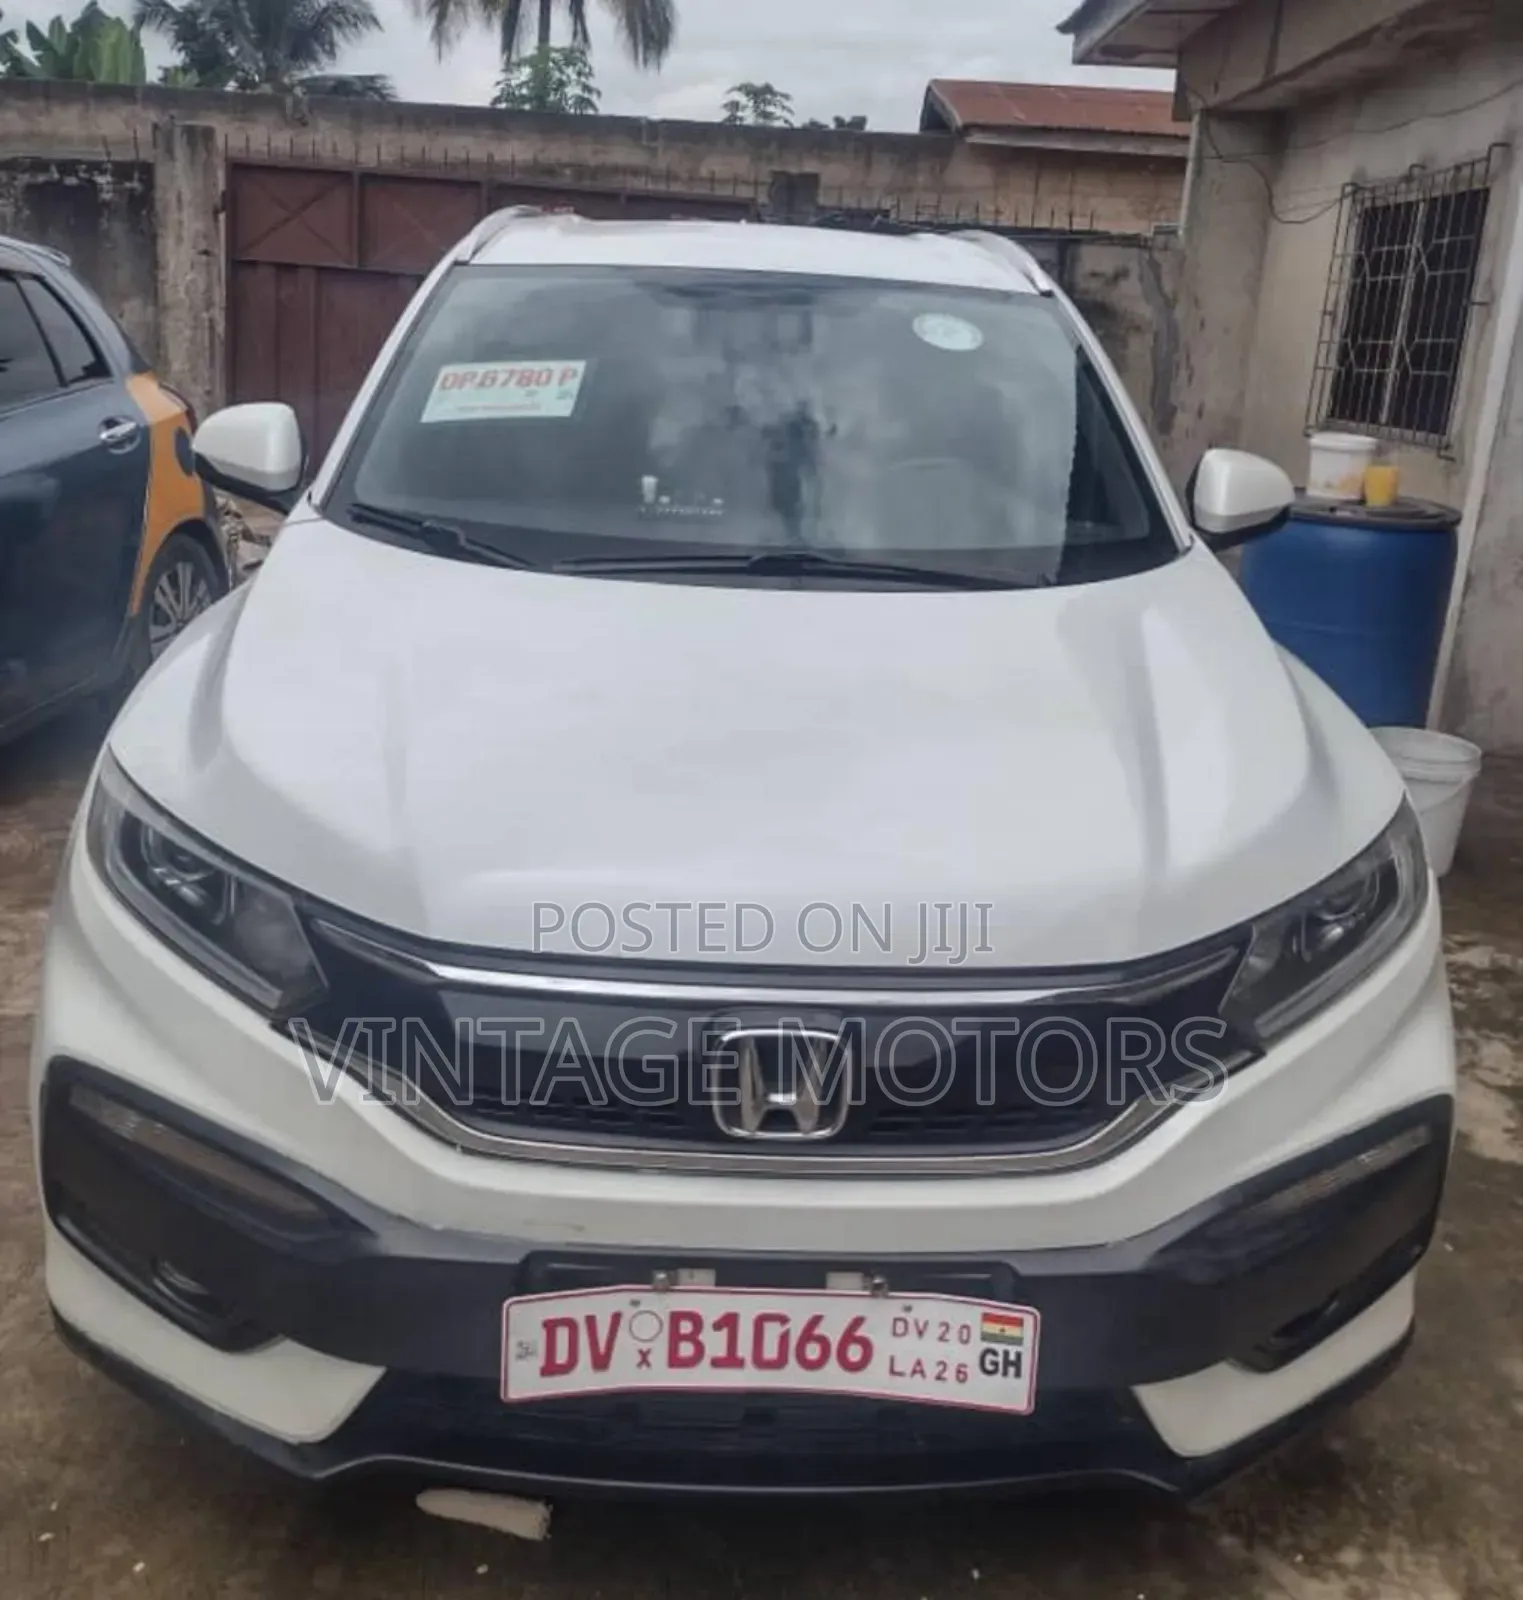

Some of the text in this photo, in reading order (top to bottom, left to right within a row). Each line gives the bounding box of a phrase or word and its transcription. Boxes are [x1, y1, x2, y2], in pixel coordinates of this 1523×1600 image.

[538, 1311, 623, 1378] DV
[667, 1310, 875, 1374] B1066
[978, 1347, 1022, 1379] GH
